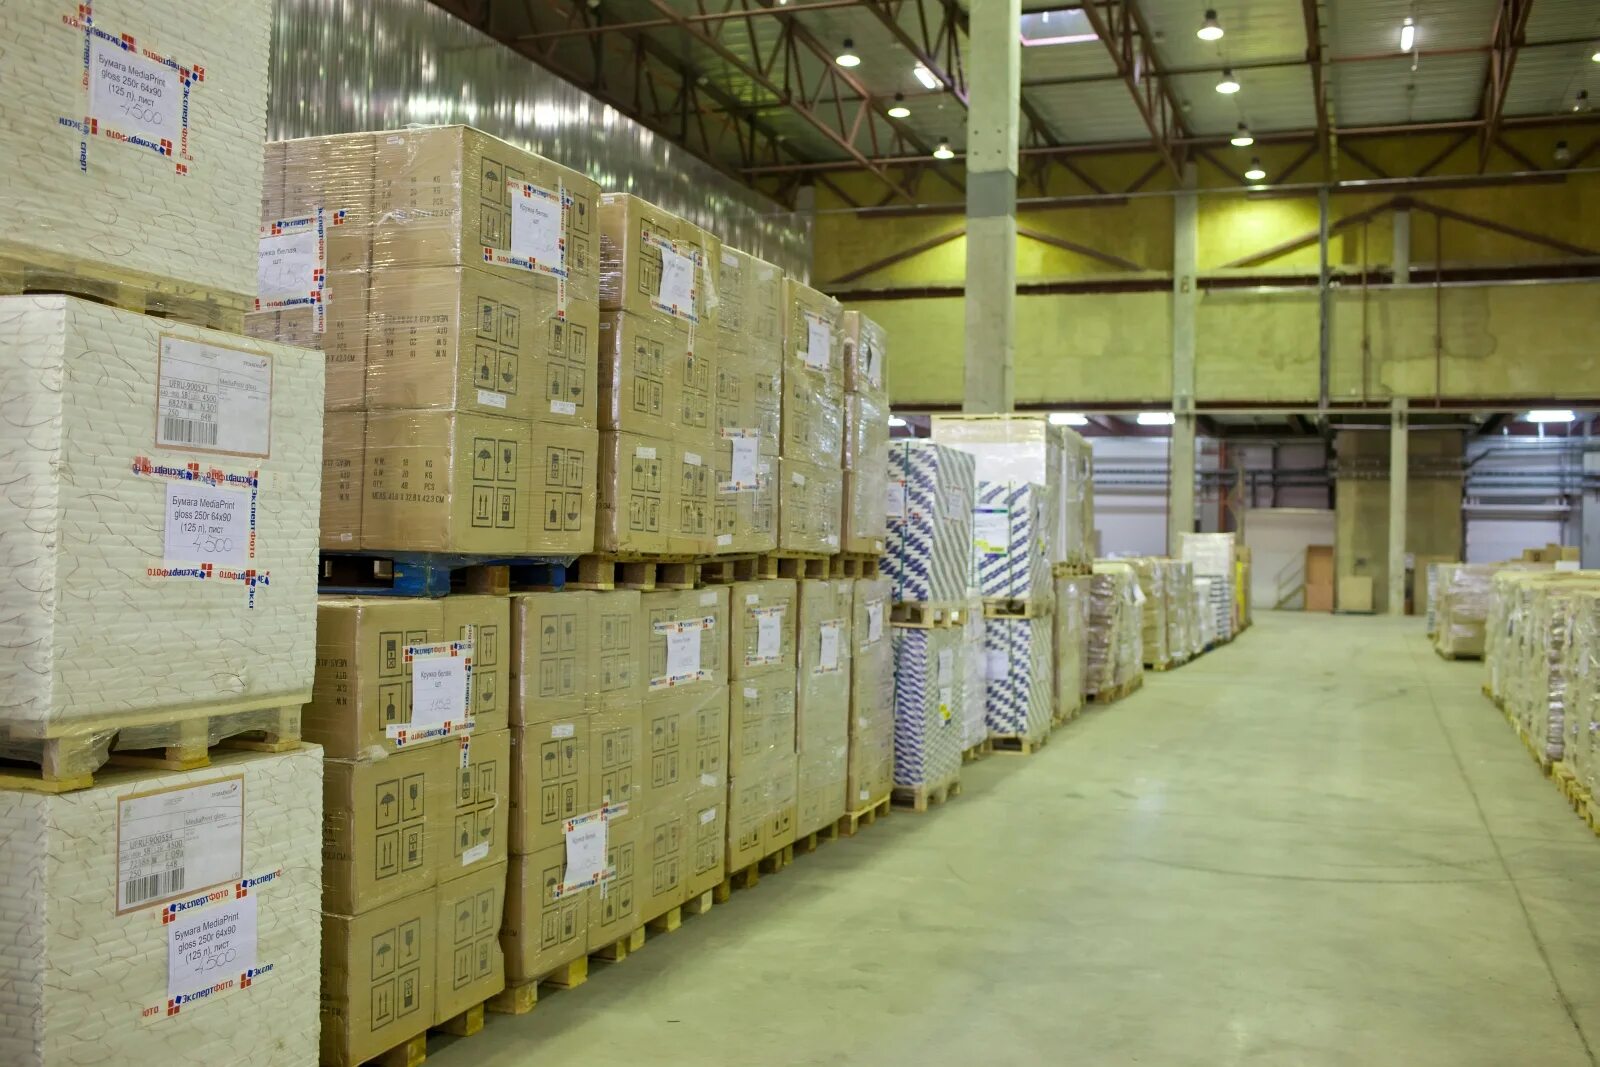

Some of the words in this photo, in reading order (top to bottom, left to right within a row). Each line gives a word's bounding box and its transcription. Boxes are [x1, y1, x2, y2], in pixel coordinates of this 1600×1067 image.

[98, 54, 126, 71] Бумага
[128, 66, 166, 87] MediaPrint
[101, 69, 121, 83] gloss
[108, 83, 125, 97] (125
[172, 495, 198, 508] Бумага
[199, 498, 235, 510] MediaPrint
[174, 510, 193, 521] gloss
[180, 522, 197, 533] (125
[174, 926, 201, 941] Бумага
[202, 912, 239, 931] MediaPrint
[178, 939, 197, 955] gloss
[185, 949, 201, 966] (125
[213, 940, 230, 953] лист
